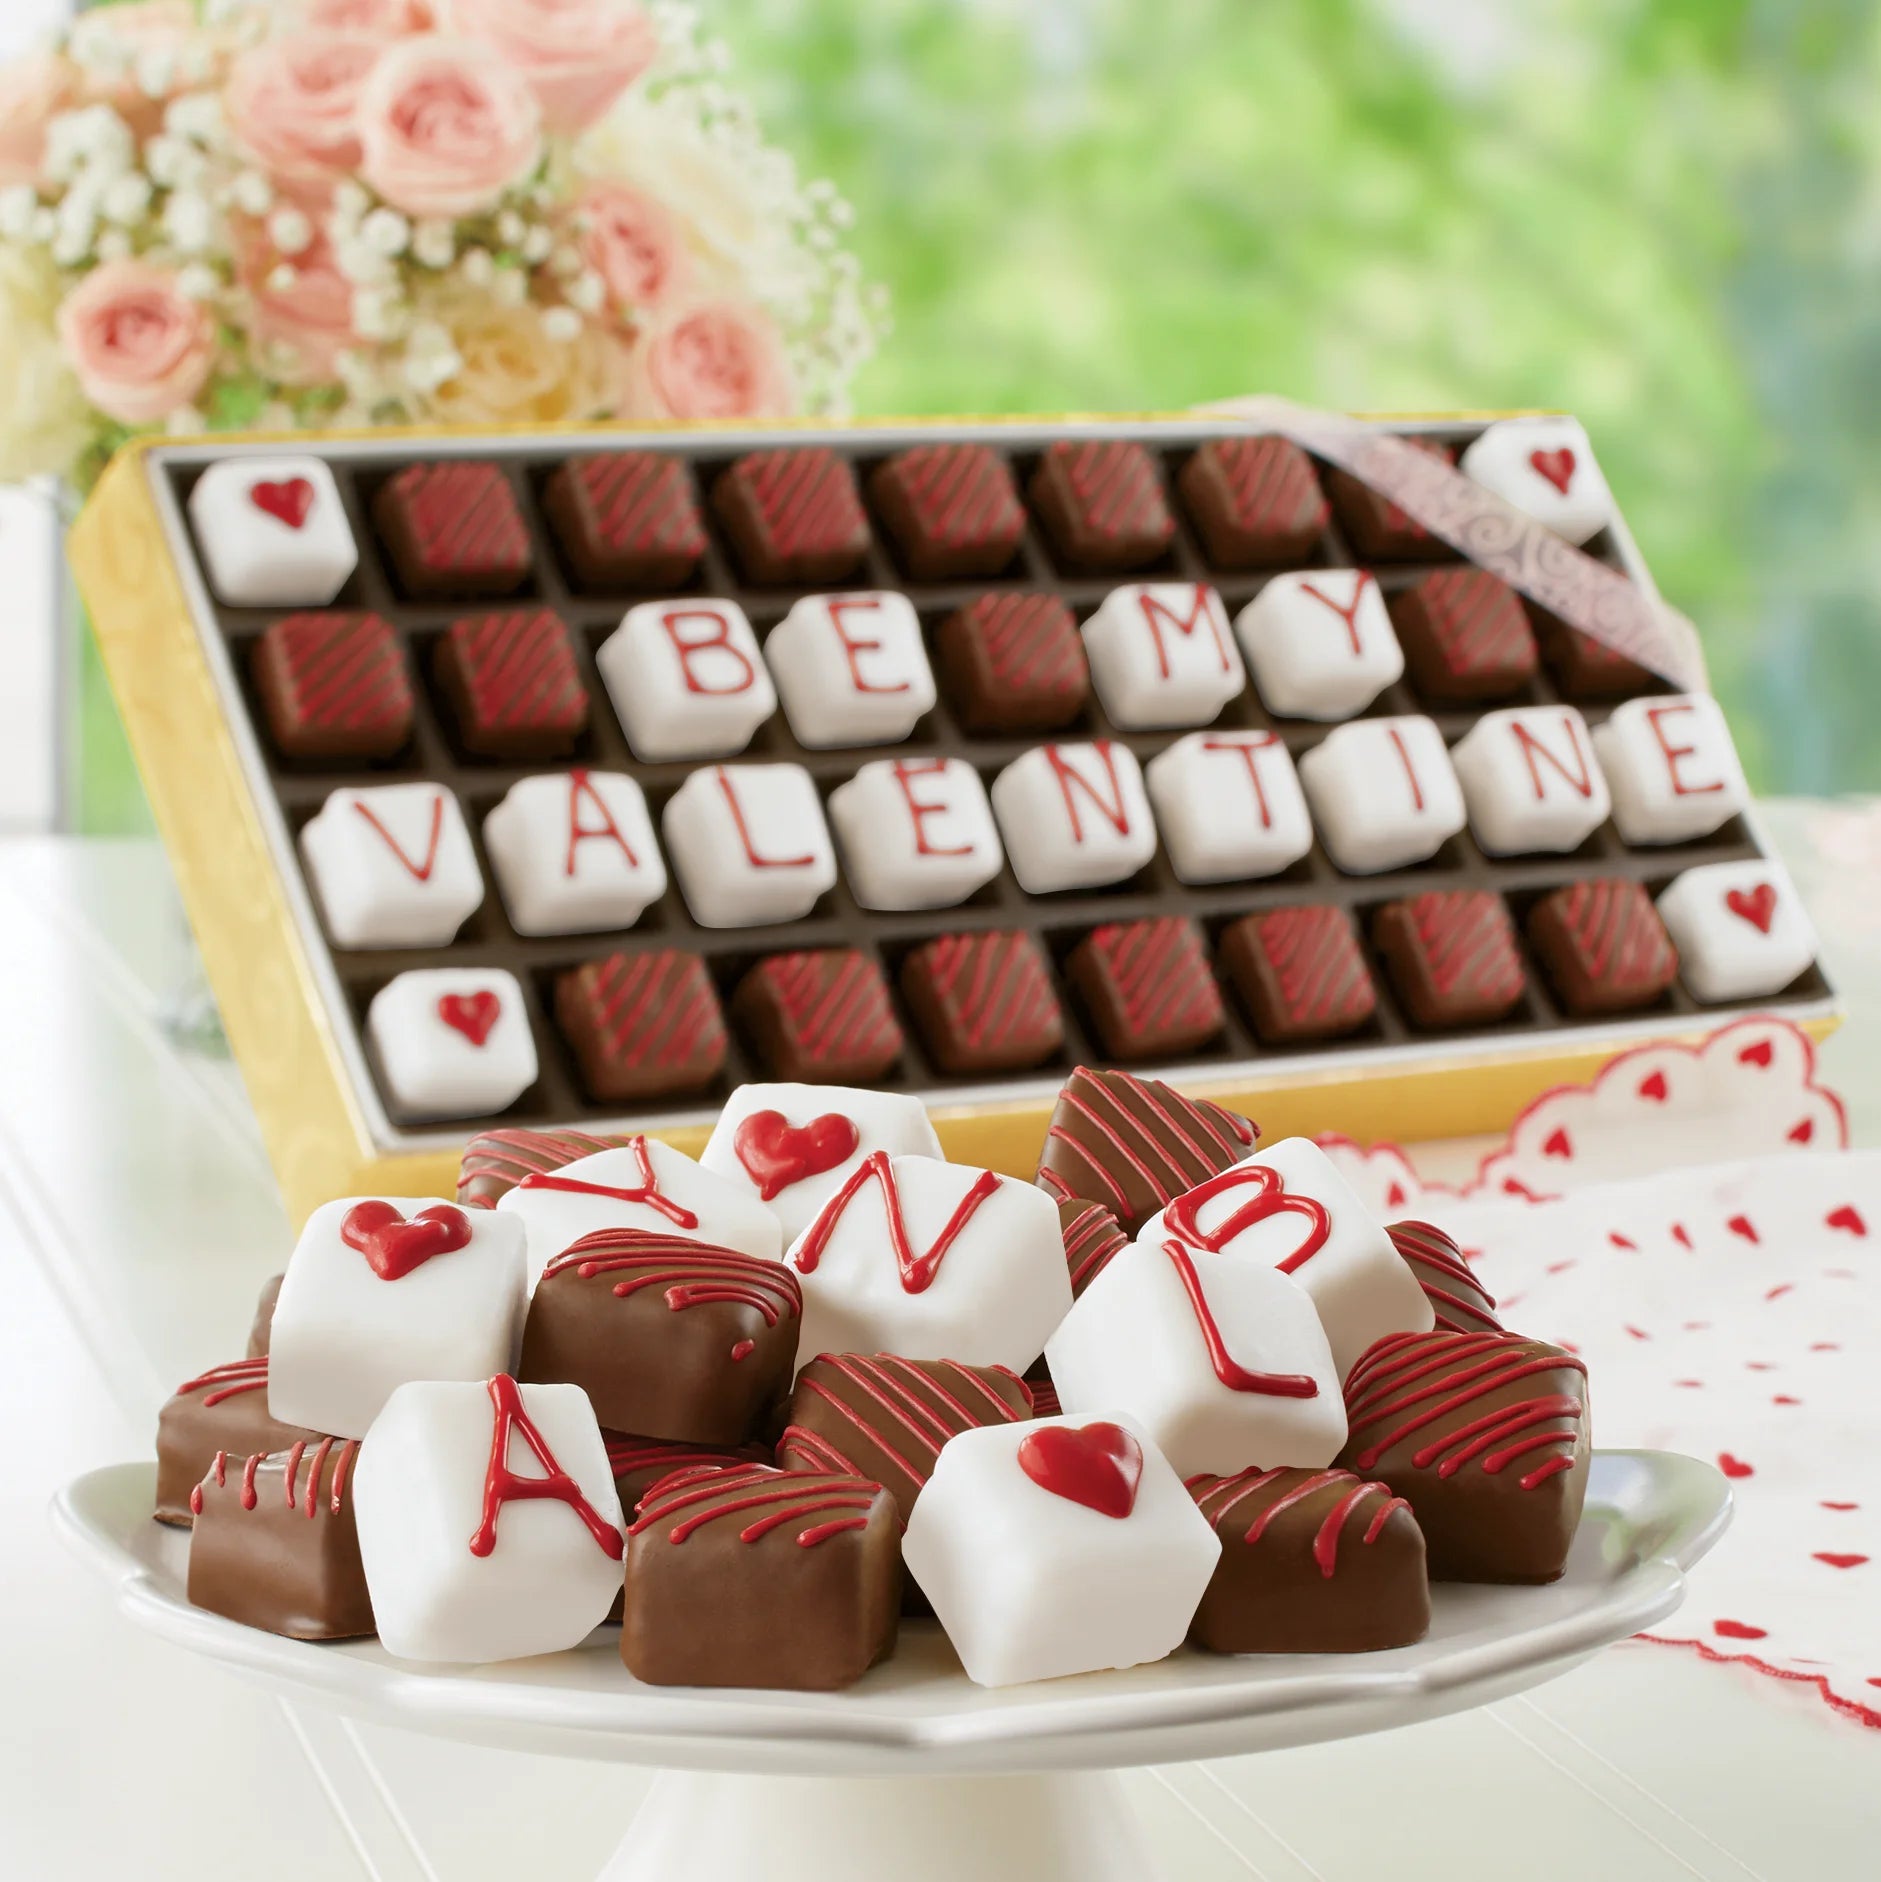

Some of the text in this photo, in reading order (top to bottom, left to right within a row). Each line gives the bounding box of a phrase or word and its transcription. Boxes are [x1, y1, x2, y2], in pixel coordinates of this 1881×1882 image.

[662, 572, 1375, 695] BE MY
[355, 706, 1724, 881] VALENTINE
[519, 1136, 698, 1229] Y
[795, 1150, 1000, 1294] N
[1164, 1165, 1332, 1274] B
[1163, 1240, 1318, 1398] L
[469, 1373, 624, 1560] A
